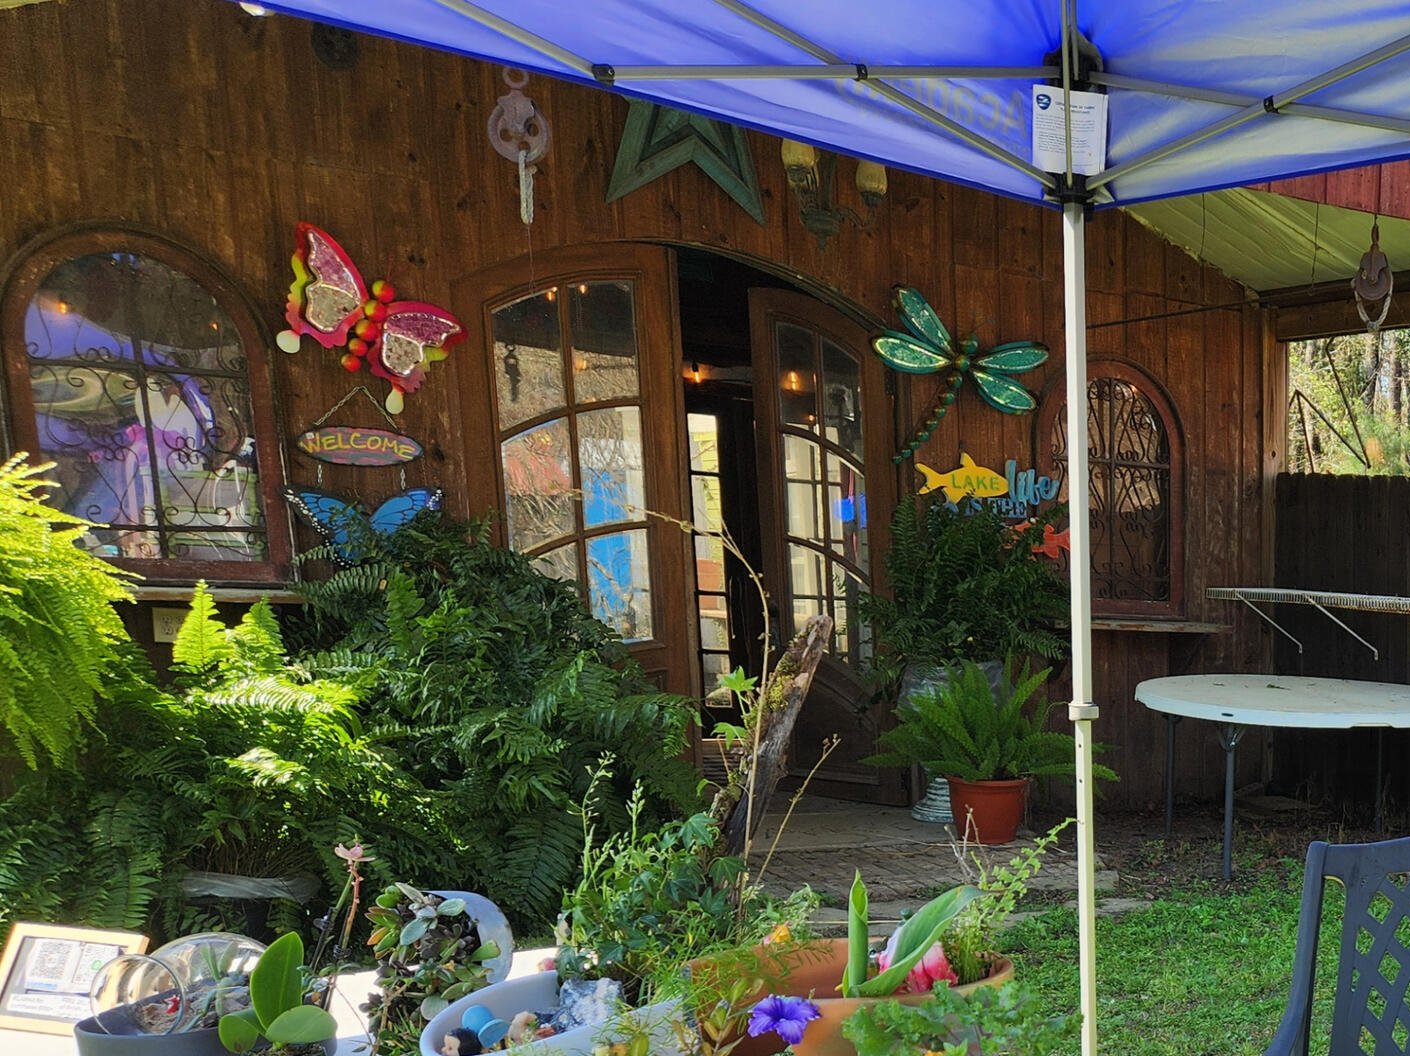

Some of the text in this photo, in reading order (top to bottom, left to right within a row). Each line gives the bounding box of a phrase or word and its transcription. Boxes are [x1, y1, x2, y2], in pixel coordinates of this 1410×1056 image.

[299, 431, 416, 460] WELCOME
[951, 460, 1059, 505] LAKE life
